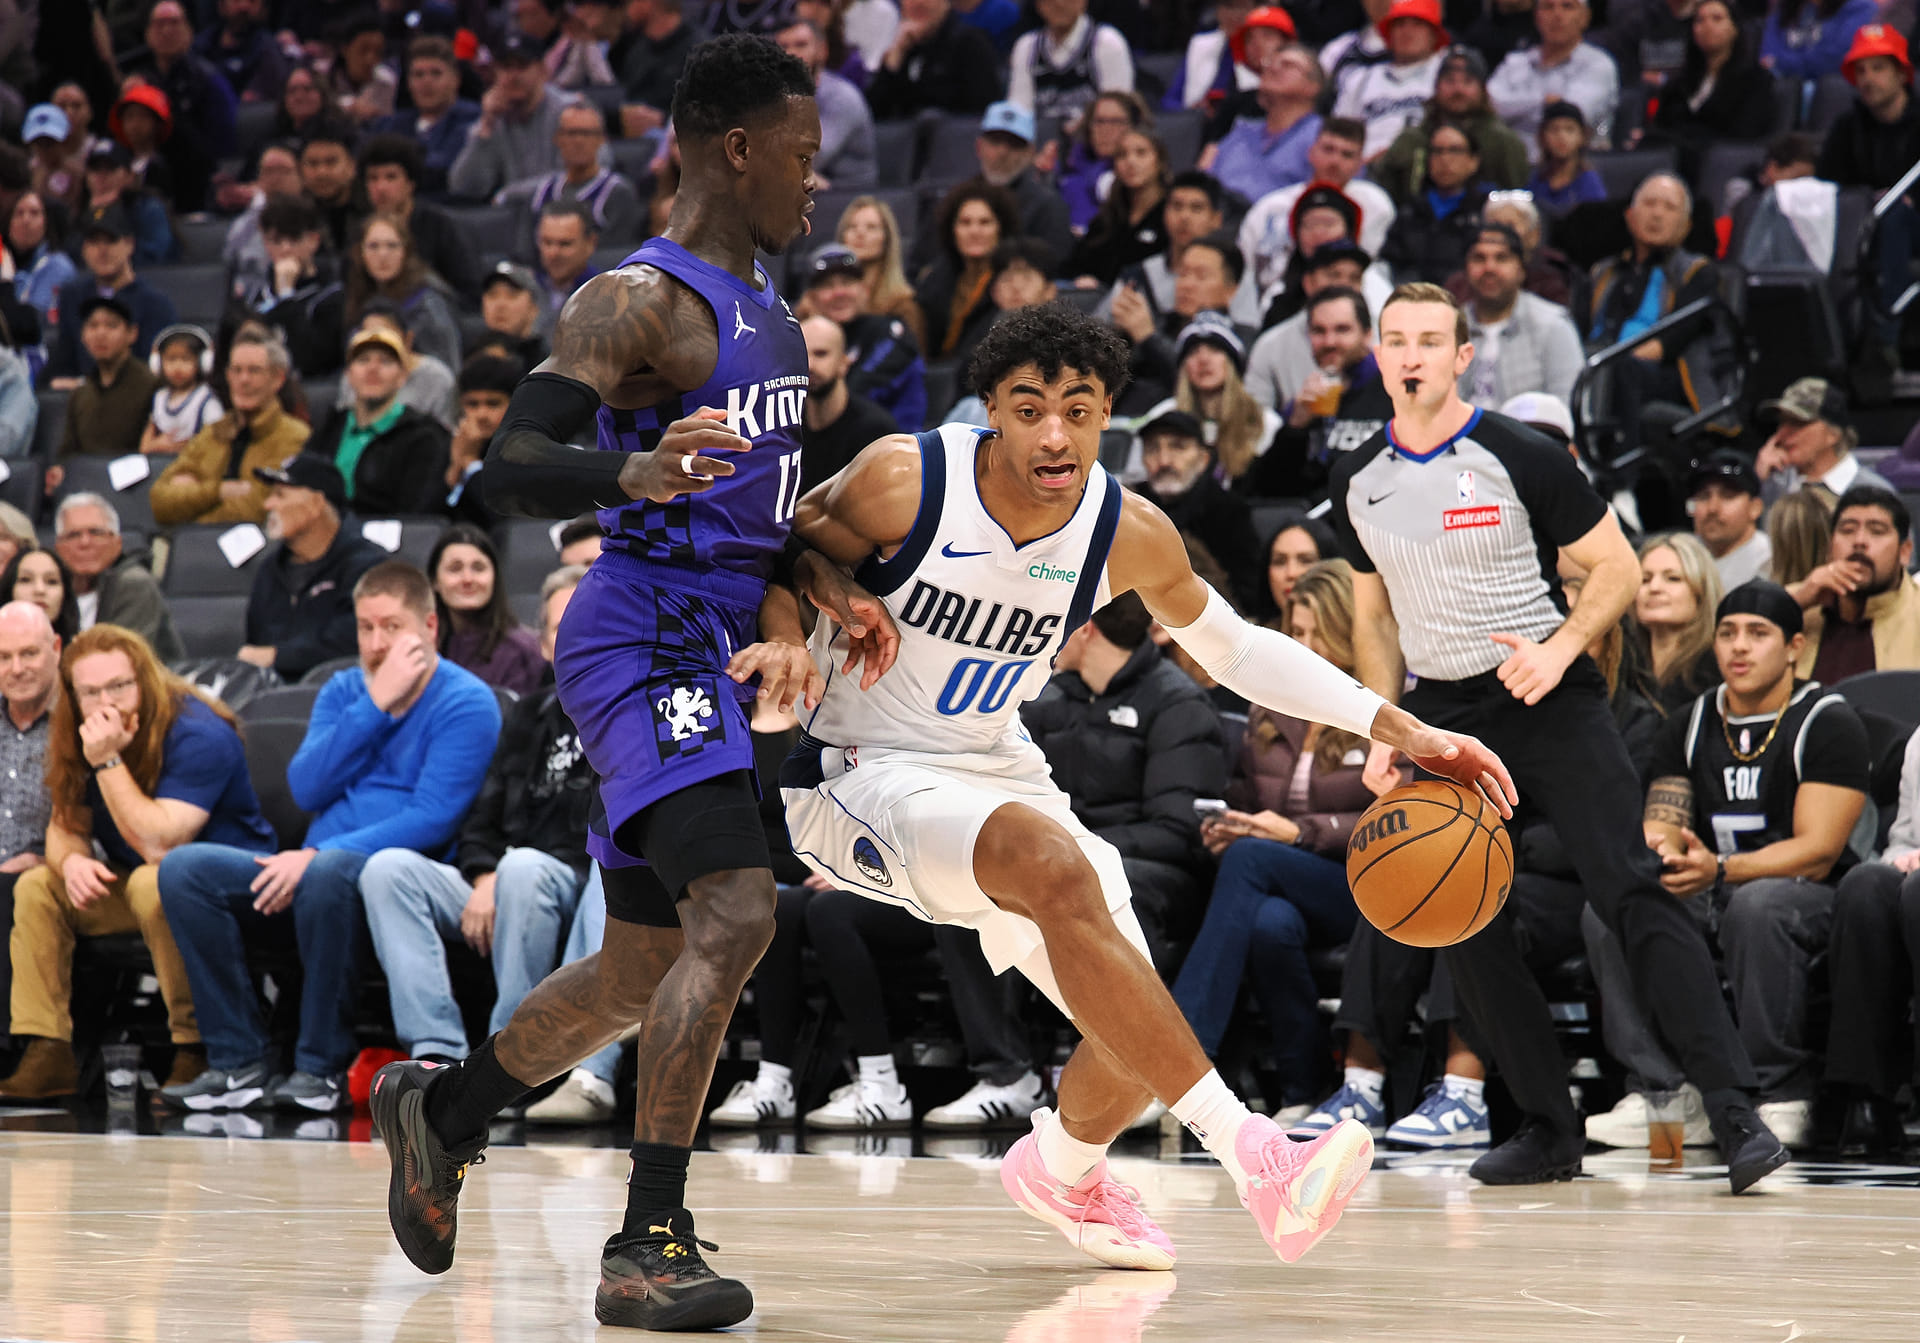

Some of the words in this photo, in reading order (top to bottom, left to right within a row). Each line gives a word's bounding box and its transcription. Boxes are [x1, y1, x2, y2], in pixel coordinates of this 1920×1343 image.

[775, 449, 803, 524] 17
[1444, 509, 1500, 528] Emirates
[1028, 562, 1077, 584] chime
[899, 578, 1063, 657] DALLAS
[936, 657, 1036, 716] 00
[1723, 766, 1761, 801] FOX
